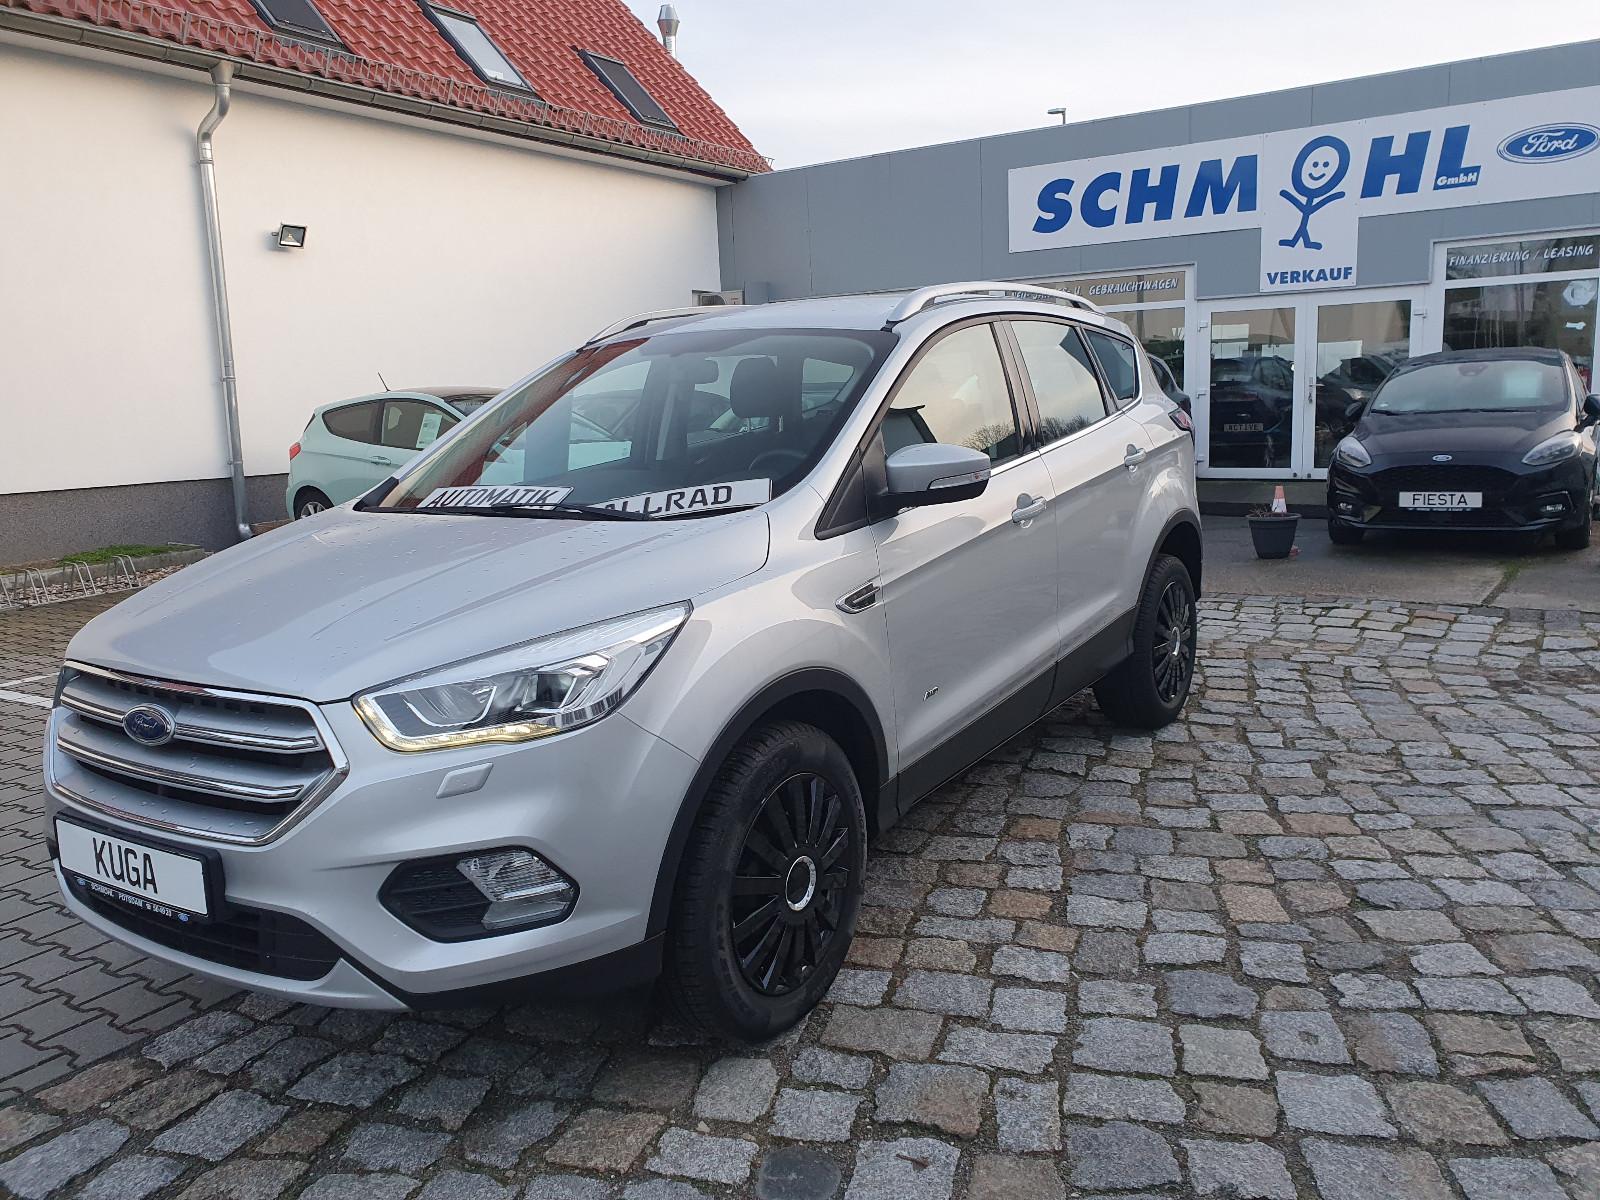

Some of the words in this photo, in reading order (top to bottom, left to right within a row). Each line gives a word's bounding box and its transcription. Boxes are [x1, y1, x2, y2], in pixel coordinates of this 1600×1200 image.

[1519, 129, 1580, 158] Ford
[1436, 171, 1479, 188] GmbH
[1449, 249, 1530, 267] FINANZIERUNG
[1543, 243, 1594, 260] LEASING
[1088, 278, 1179, 296] GEBRAUCHTWAGEN
[1266, 265, 1354, 288] VERKAUF
[427, 488, 559, 508] AUTOMATIK
[1412, 493, 1468, 506] FIESTA
[92, 837, 159, 895] KUGA
